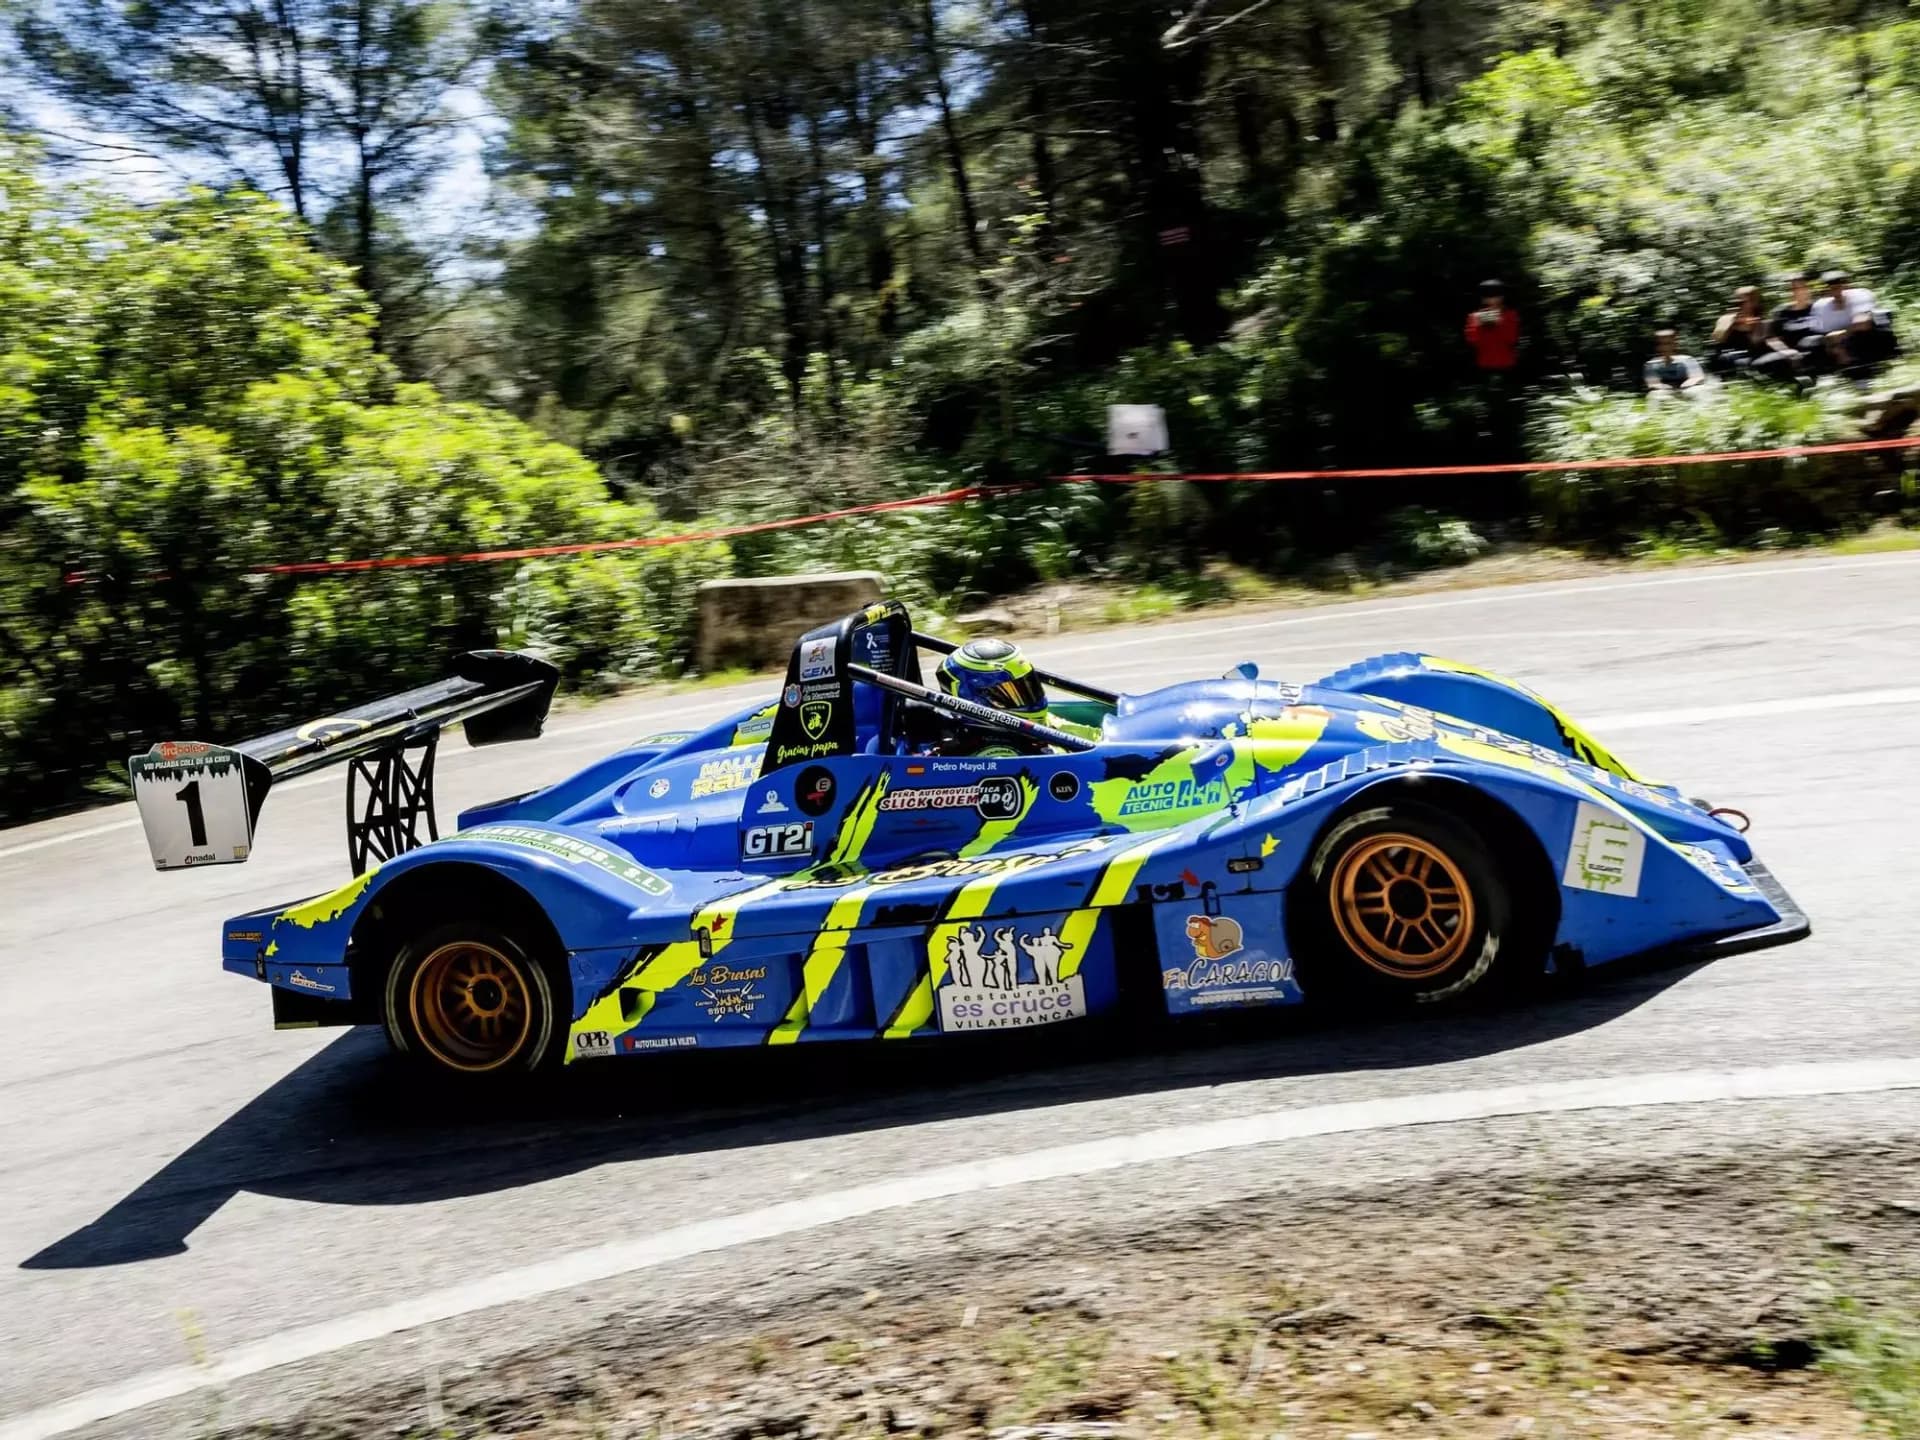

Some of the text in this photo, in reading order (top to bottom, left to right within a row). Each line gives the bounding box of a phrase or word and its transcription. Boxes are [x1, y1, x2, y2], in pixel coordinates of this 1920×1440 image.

[940, 692, 1021, 728] Mayolracingteam
[777, 745, 810, 764] Gracias
[155, 760, 179, 769] PUJADA
[180, 759, 194, 767] COLL
[932, 762, 997, 773] Pedro Mayol JR
[892, 788, 917, 799] PEÑA
[1127, 782, 1176, 801] AUTO
[880, 796, 927, 810] SLICK
[1125, 797, 1173, 814] TECNIC
[176, 781, 208, 847] 1
[745, 822, 813, 855] GT2i
[193, 853, 216, 862] nadal
[687, 965, 767, 987] Las Brasas
[952, 983, 1070, 1002] restaurant
[735, 1002, 755, 1015] Grill
[953, 993, 1072, 1018] es cruce
[955, 1009, 1074, 1029] VILAFRANCA
[577, 1031, 610, 1048] OPB
[634, 1038, 669, 1049] AUTOTALLER
[679, 1037, 697, 1046] VILETA
